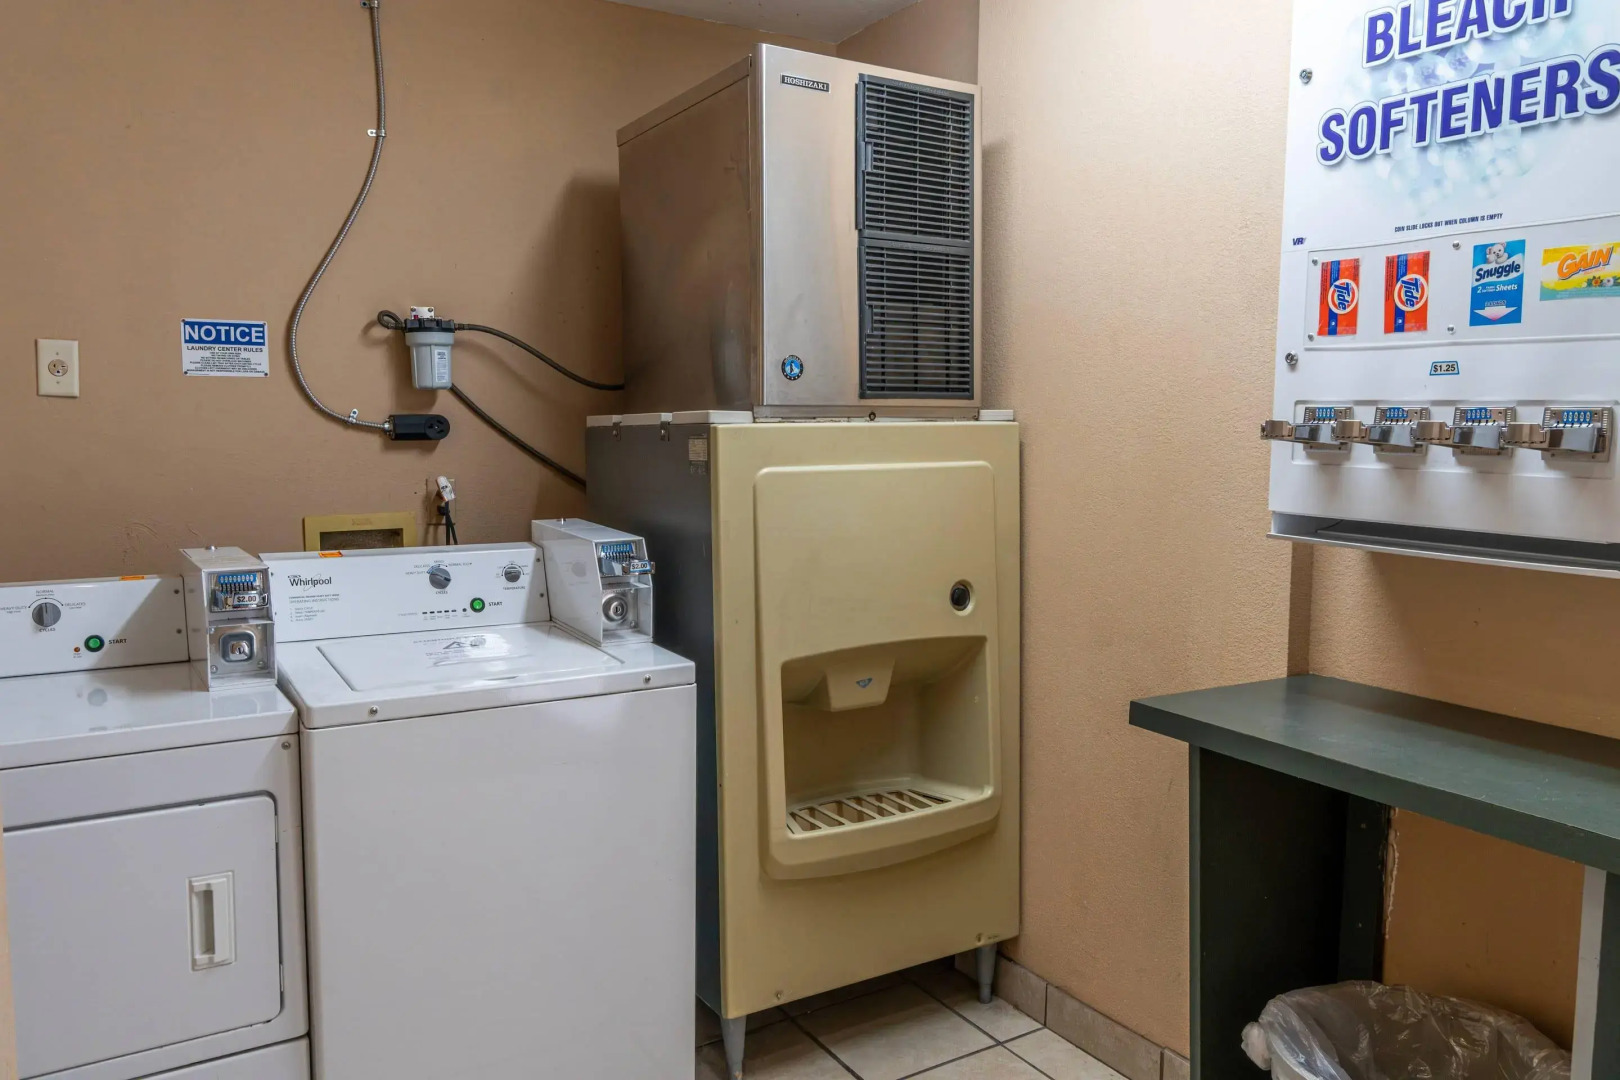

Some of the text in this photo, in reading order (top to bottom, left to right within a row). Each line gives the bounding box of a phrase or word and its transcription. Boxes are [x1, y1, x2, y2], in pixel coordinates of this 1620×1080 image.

[784, 76, 828, 91] HOSHIZAKI
[1319, 49, 1620, 162] SOFTENERS
[1394, 225, 1405, 233] COIN
[1405, 223, 1418, 231] SLIDE
[1418, 221, 1433, 230] LOCKS
[1444, 218, 1458, 226] WHEN
[1458, 215, 1479, 224] COLUMN
[1486, 212, 1504, 221] EMPTY
[1474, 260, 1521, 283] Snuggle
[1556, 245, 1615, 281] GAIN
[1332, 281, 1352, 311] Tide
[1400, 277, 1420, 308] Tide
[1495, 283, 1518, 292] Sheets
[184, 324, 265, 343] NOTICE
[1433, 363, 1456, 373] $1.25
[631, 562, 648, 570] $2.00
[288, 576, 332, 588] Whirlpool
[236, 595, 257, 603] $2.00
